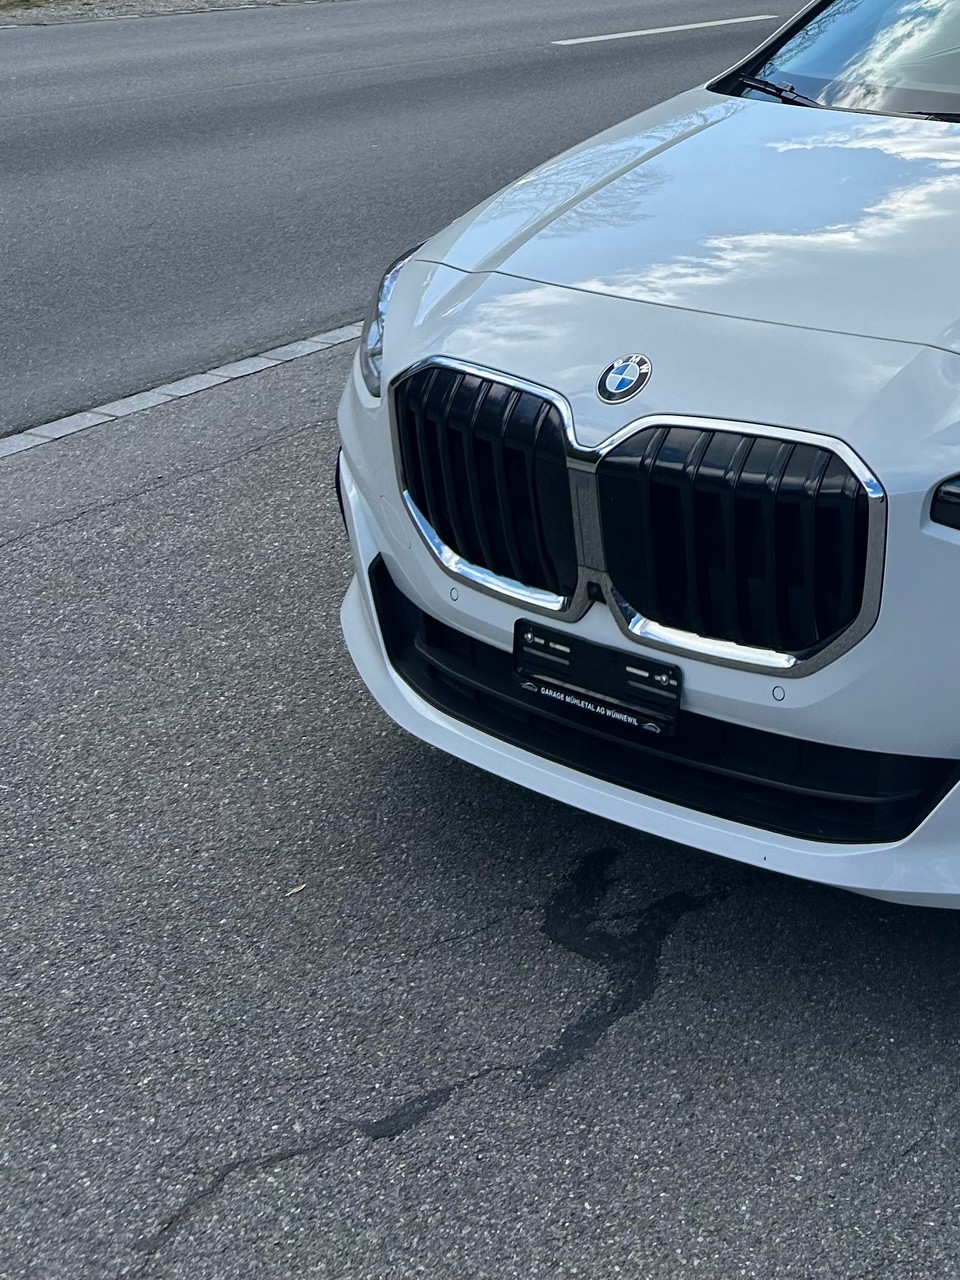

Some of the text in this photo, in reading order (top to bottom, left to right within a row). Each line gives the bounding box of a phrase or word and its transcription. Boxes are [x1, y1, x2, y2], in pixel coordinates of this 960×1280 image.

[613, 354, 650, 374] BMW
[541, 686, 565, 701] GARAGE
[565, 695, 595, 712] MÜHLETAL
[596, 706, 605, 715] AG
